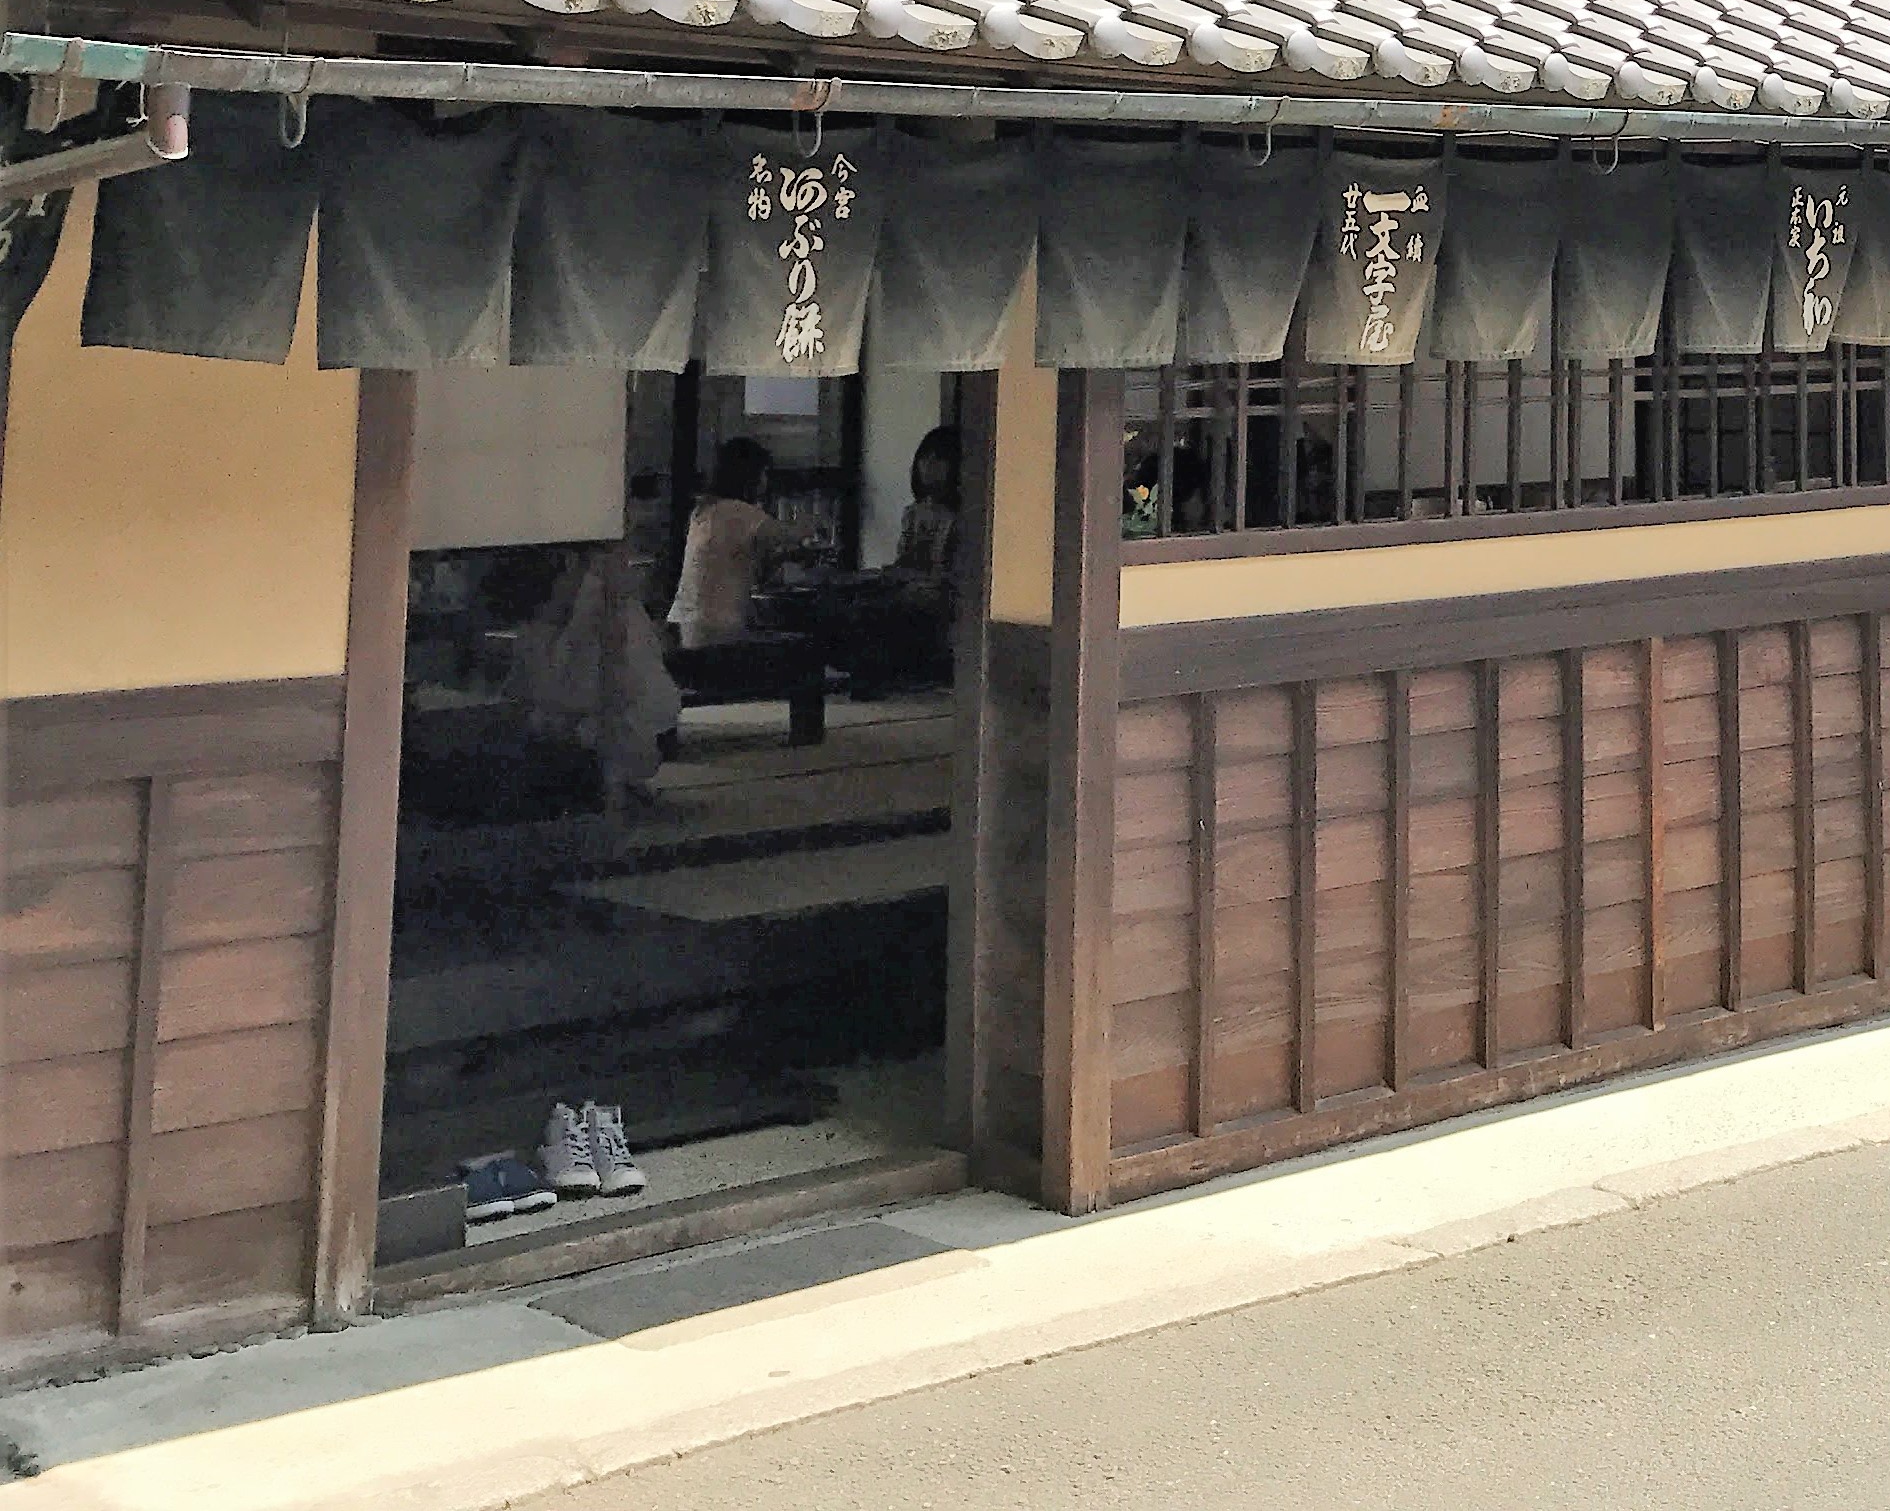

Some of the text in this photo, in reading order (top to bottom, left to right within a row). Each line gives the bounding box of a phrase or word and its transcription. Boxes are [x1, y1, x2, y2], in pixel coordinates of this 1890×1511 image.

[830, 153, 858, 219] 今宮
[1360, 190, 1412, 352] 一文字屋
